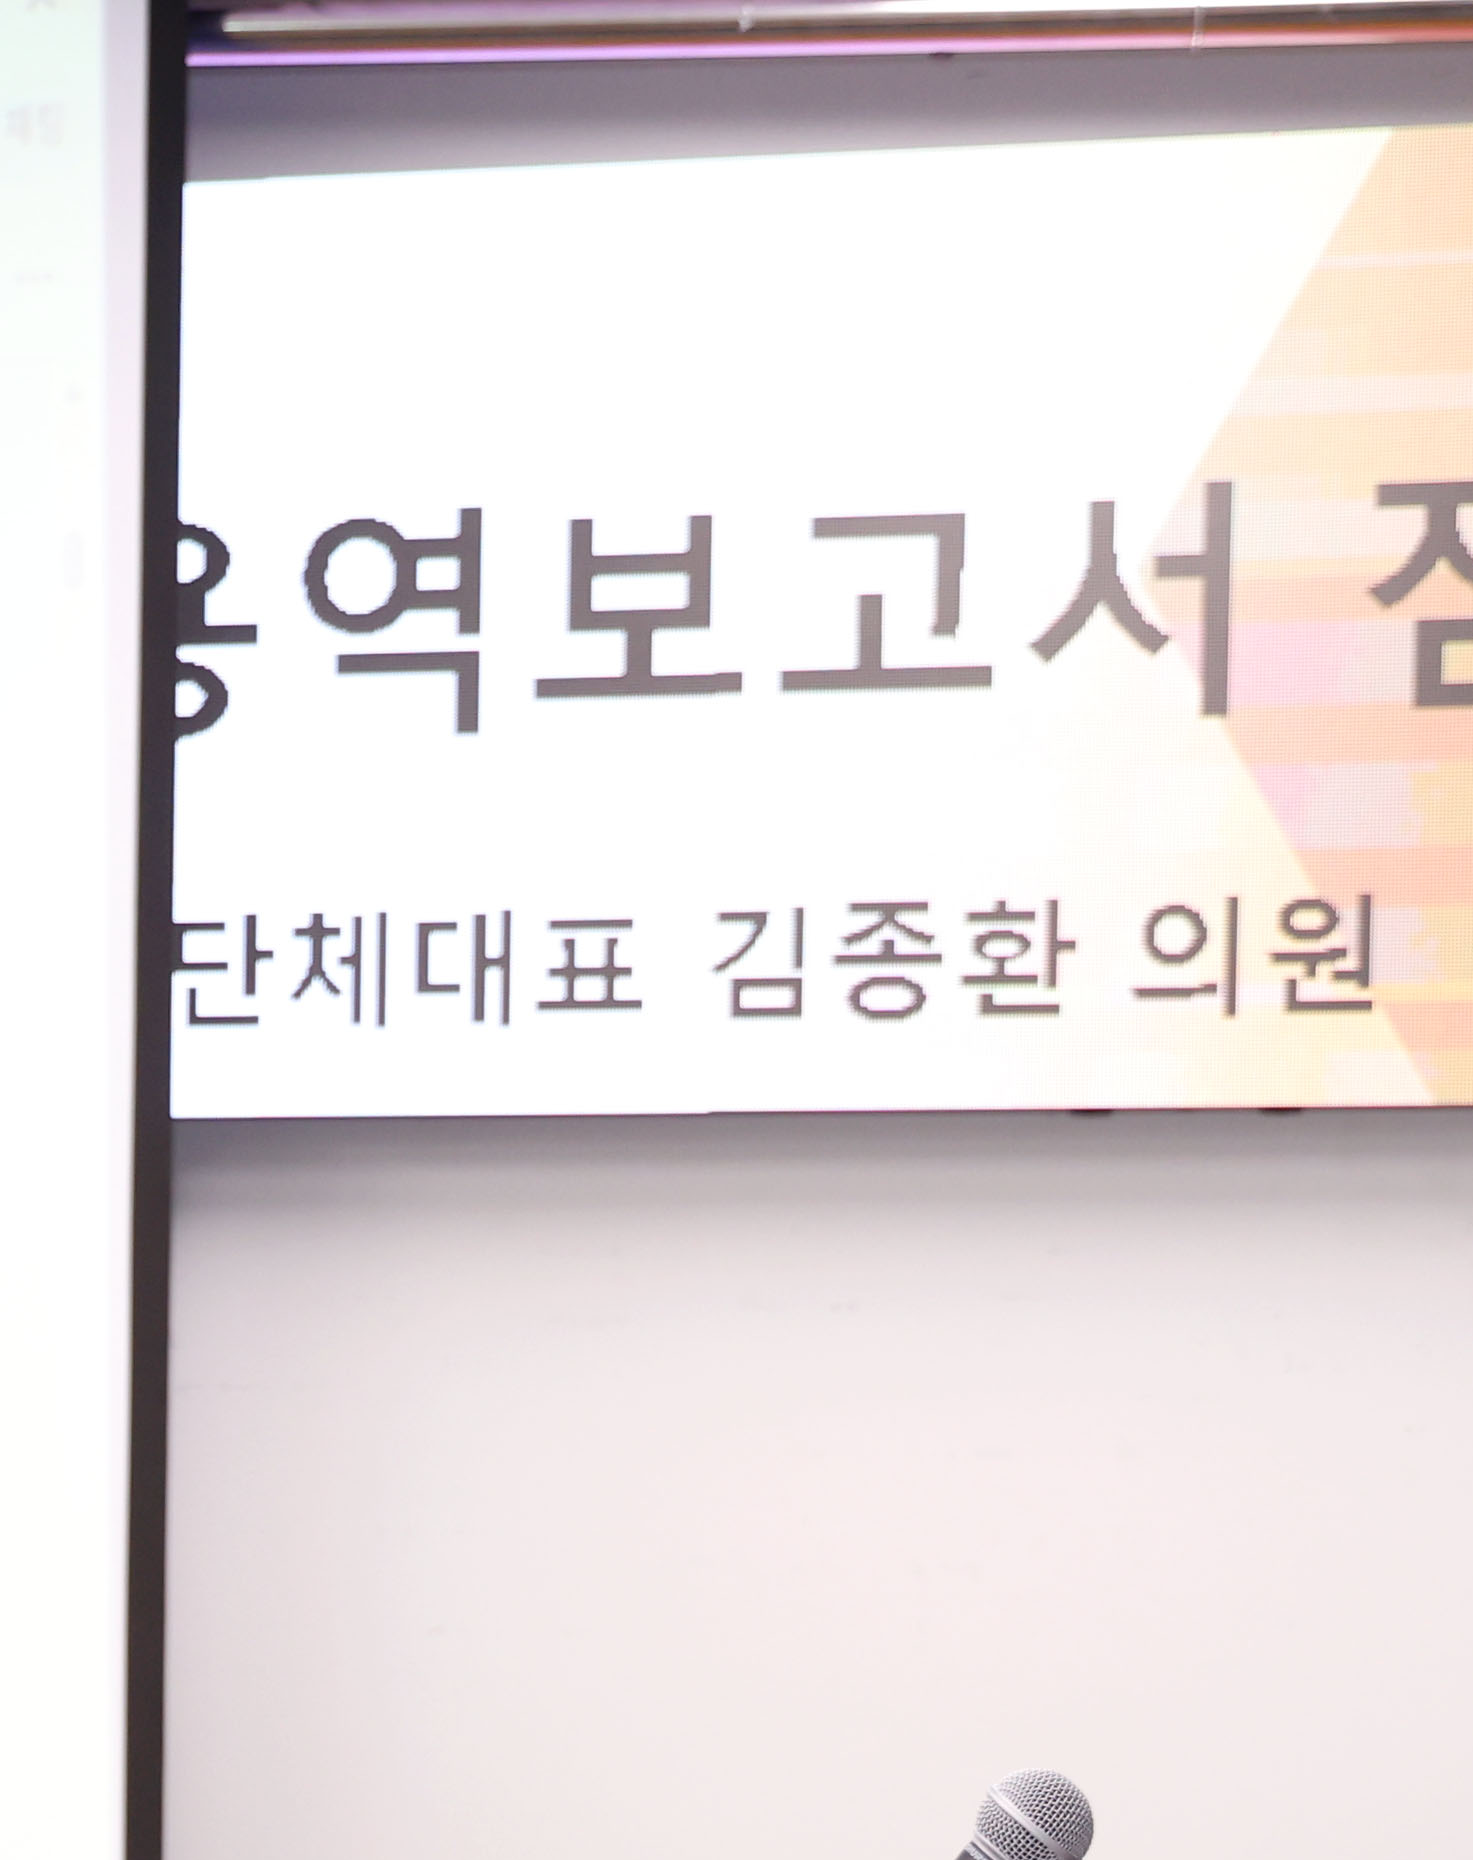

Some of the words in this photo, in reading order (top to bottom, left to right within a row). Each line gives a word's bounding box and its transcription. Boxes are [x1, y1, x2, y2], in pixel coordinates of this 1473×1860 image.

[172, 909, 645, 1027] 단체대표
[712, 896, 1078, 1022] 김종환
[1131, 891, 1378, 1018] 의원
